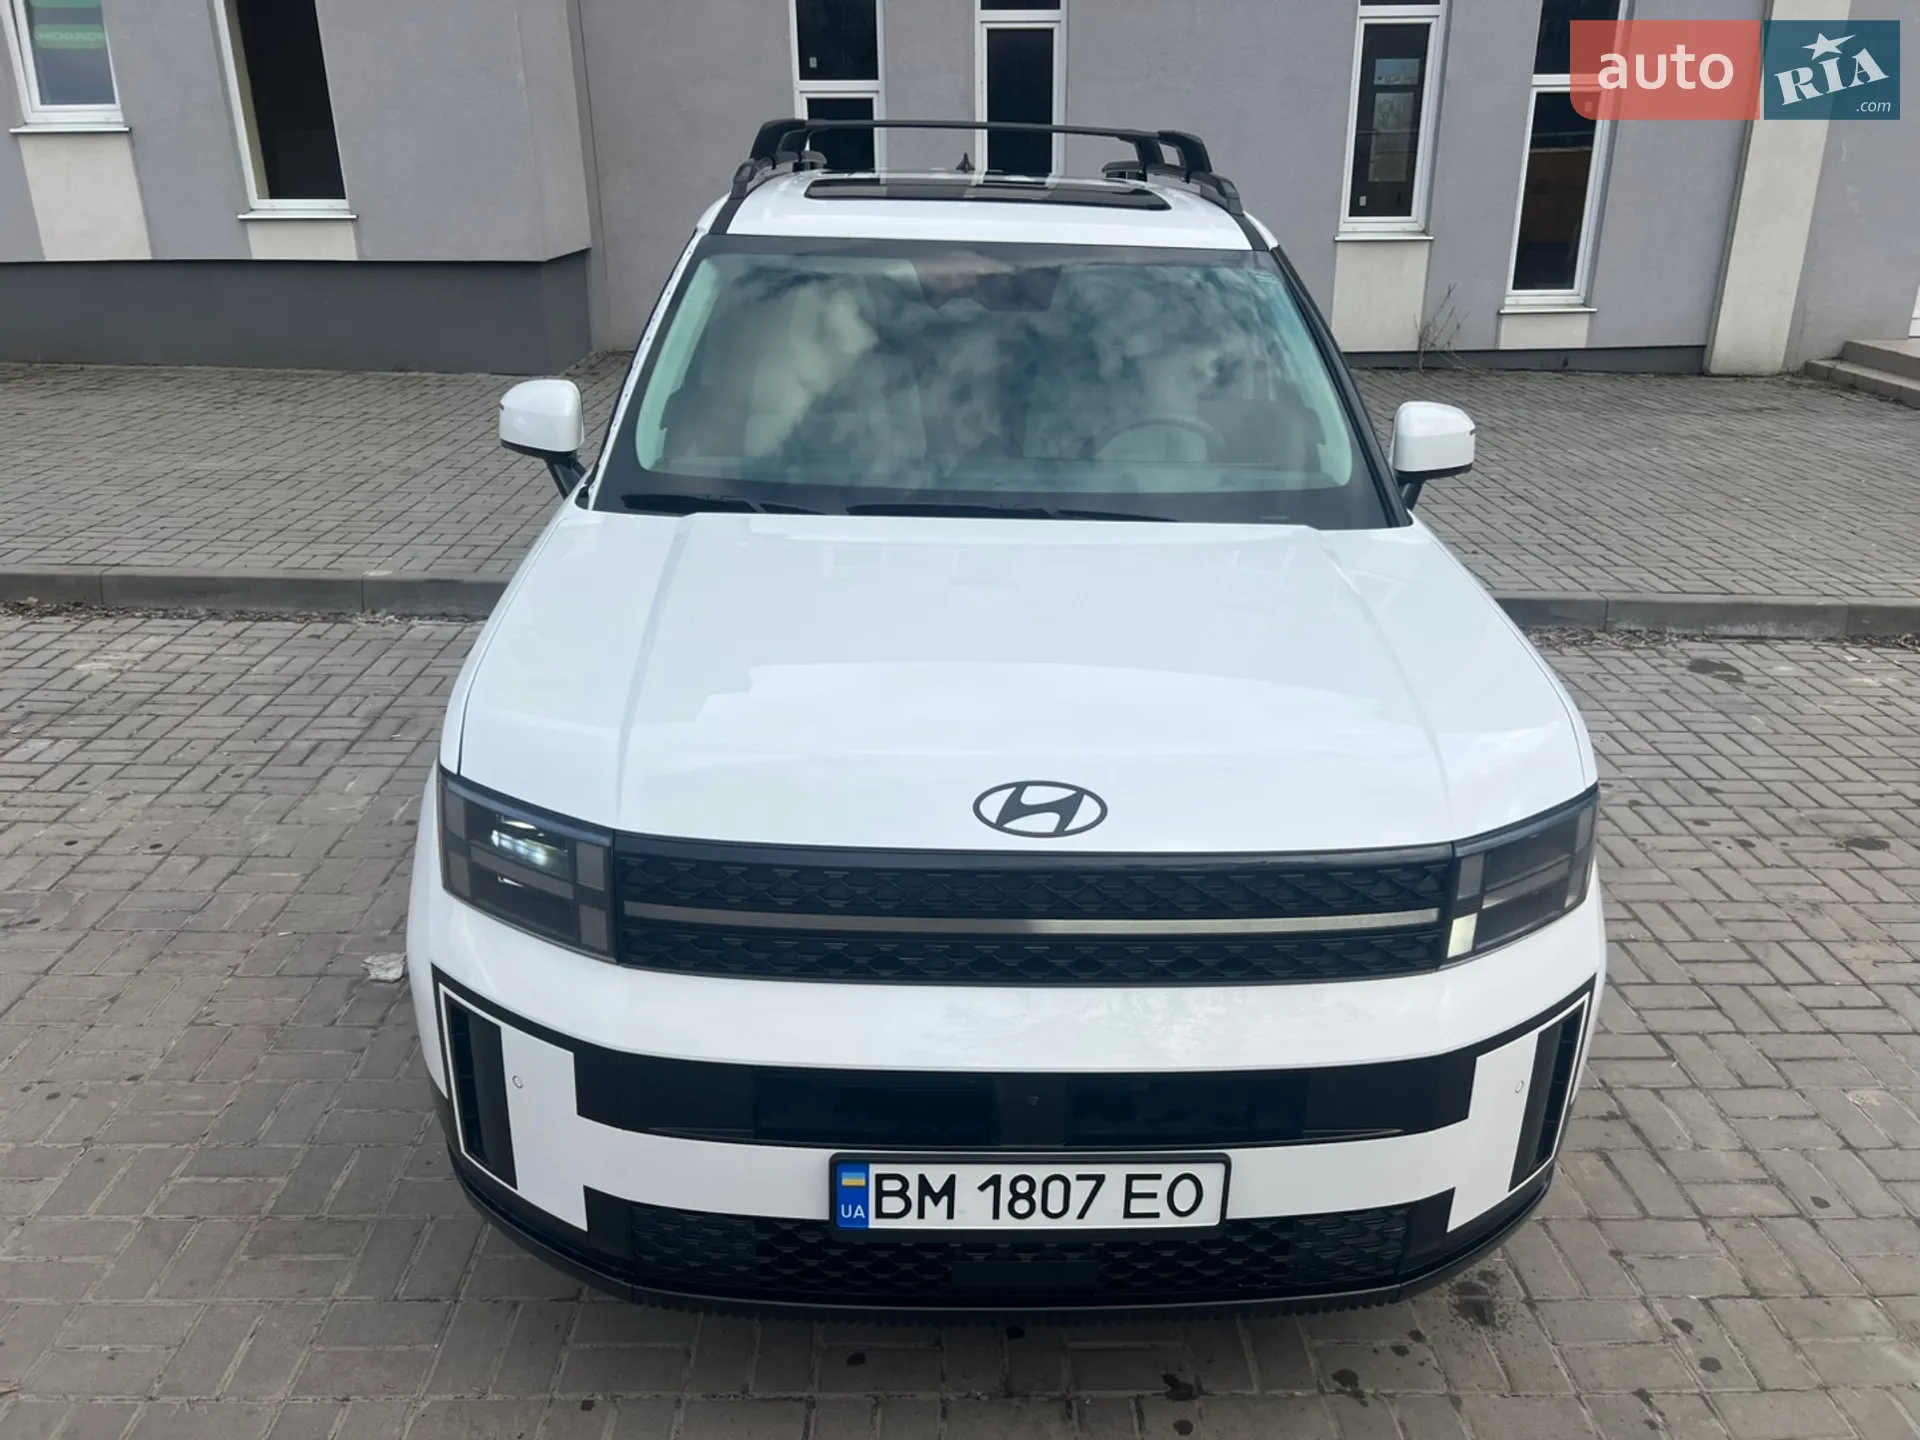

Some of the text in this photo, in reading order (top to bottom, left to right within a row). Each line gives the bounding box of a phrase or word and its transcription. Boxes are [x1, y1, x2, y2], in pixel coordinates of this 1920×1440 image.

[840, 1204, 866, 1219] UA
[874, 1171, 1204, 1220] BM 1807 EO
